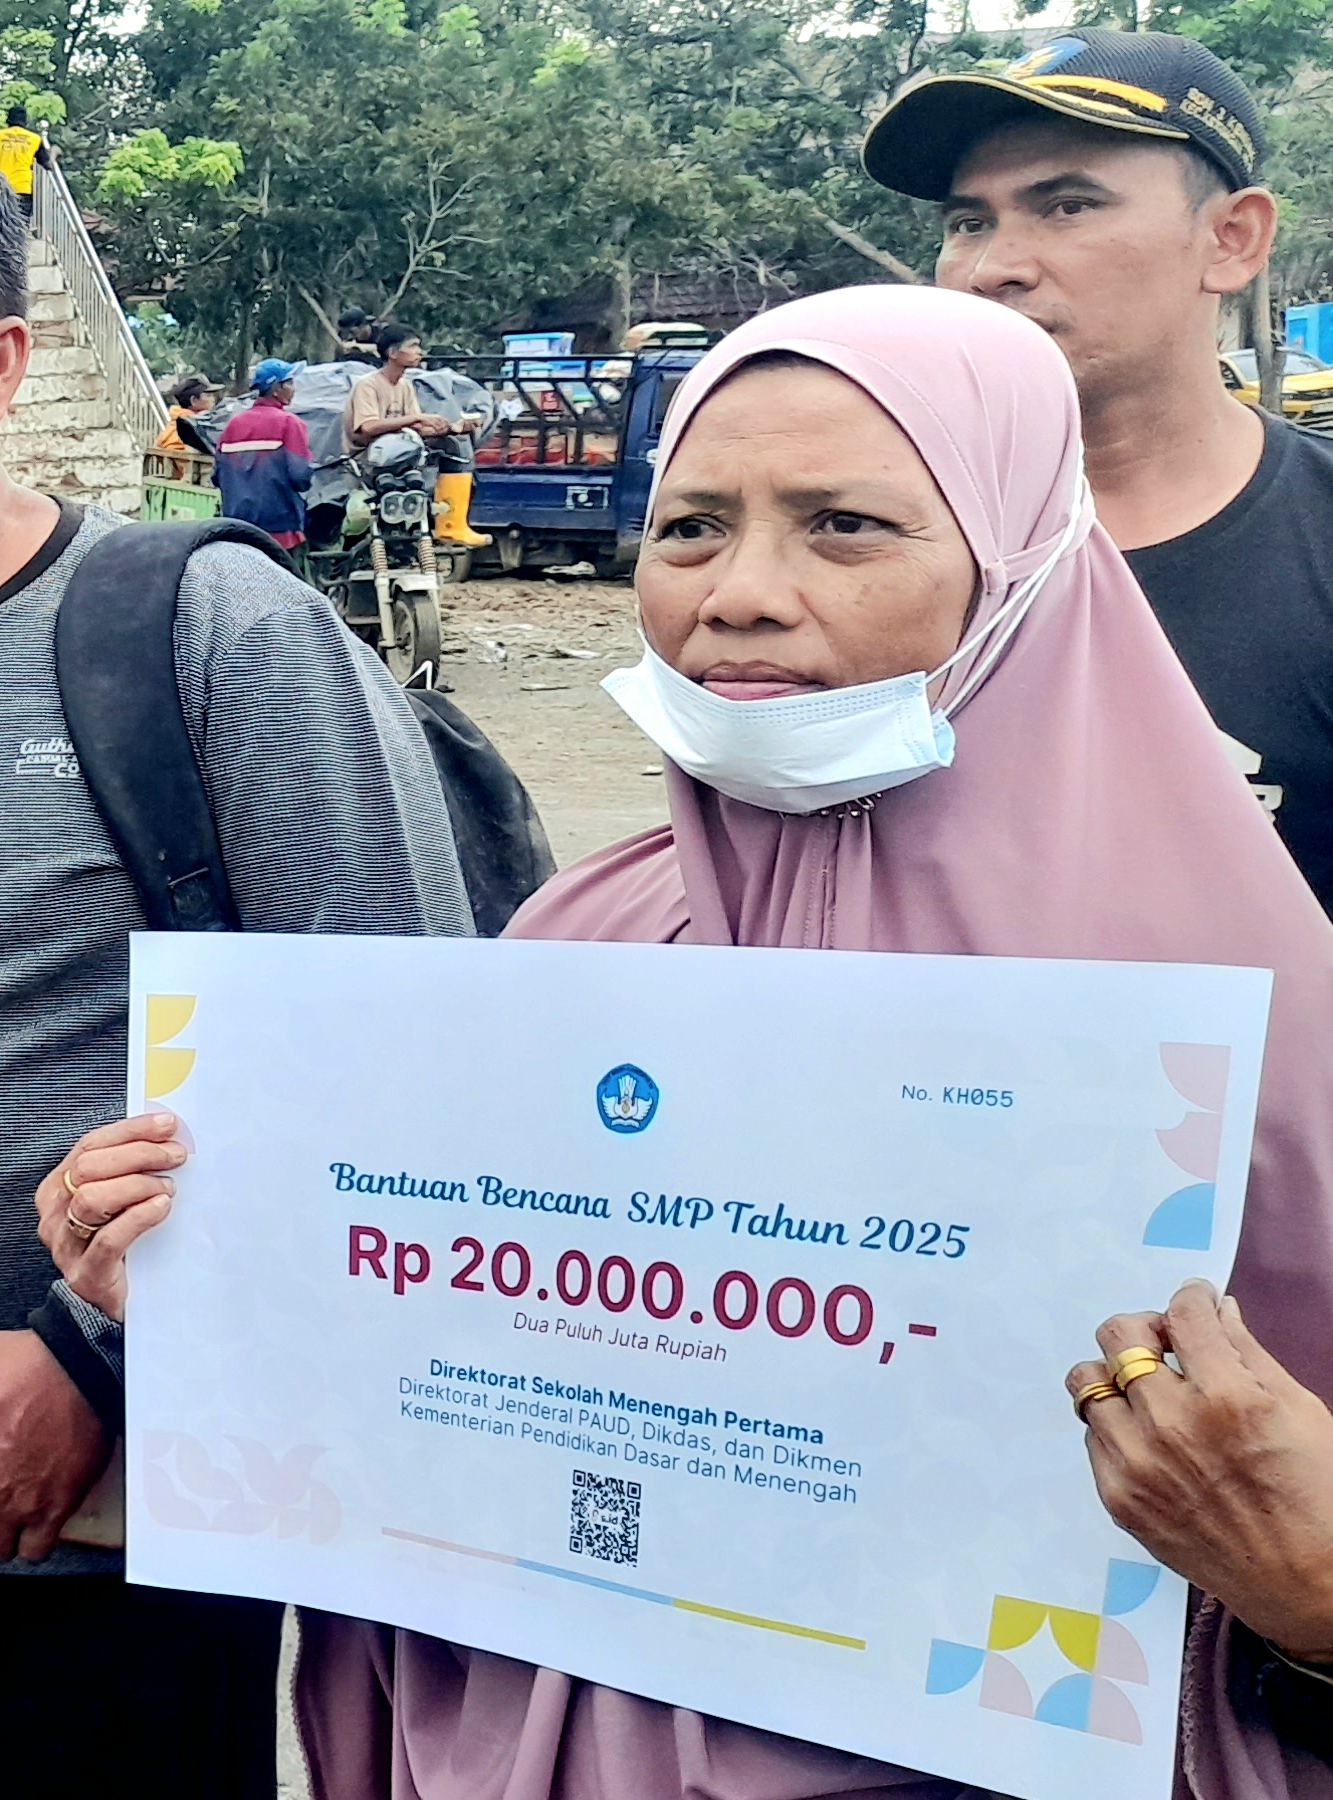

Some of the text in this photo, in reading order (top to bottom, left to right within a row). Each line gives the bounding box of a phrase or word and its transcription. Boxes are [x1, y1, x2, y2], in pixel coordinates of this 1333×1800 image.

[902, 1084, 933, 1101] No.
[329, 1162, 970, 1259] Bantuan Bencana SMP Tahun 2025
[348, 1225, 937, 1365] Rp 20.000.000,-
[513, 1312, 727, 1363] Dua Puluh Juta Rupiah
[399, 1376, 862, 1478] Direktorat Jenderal PAUD, Dikdas, dan Dikmen
[430, 1358, 823, 1445] Direktorat Sekolah Menengah Pertama
[401, 1400, 858, 1504] Kementerian Pendidikan Dasar dan Menengah
